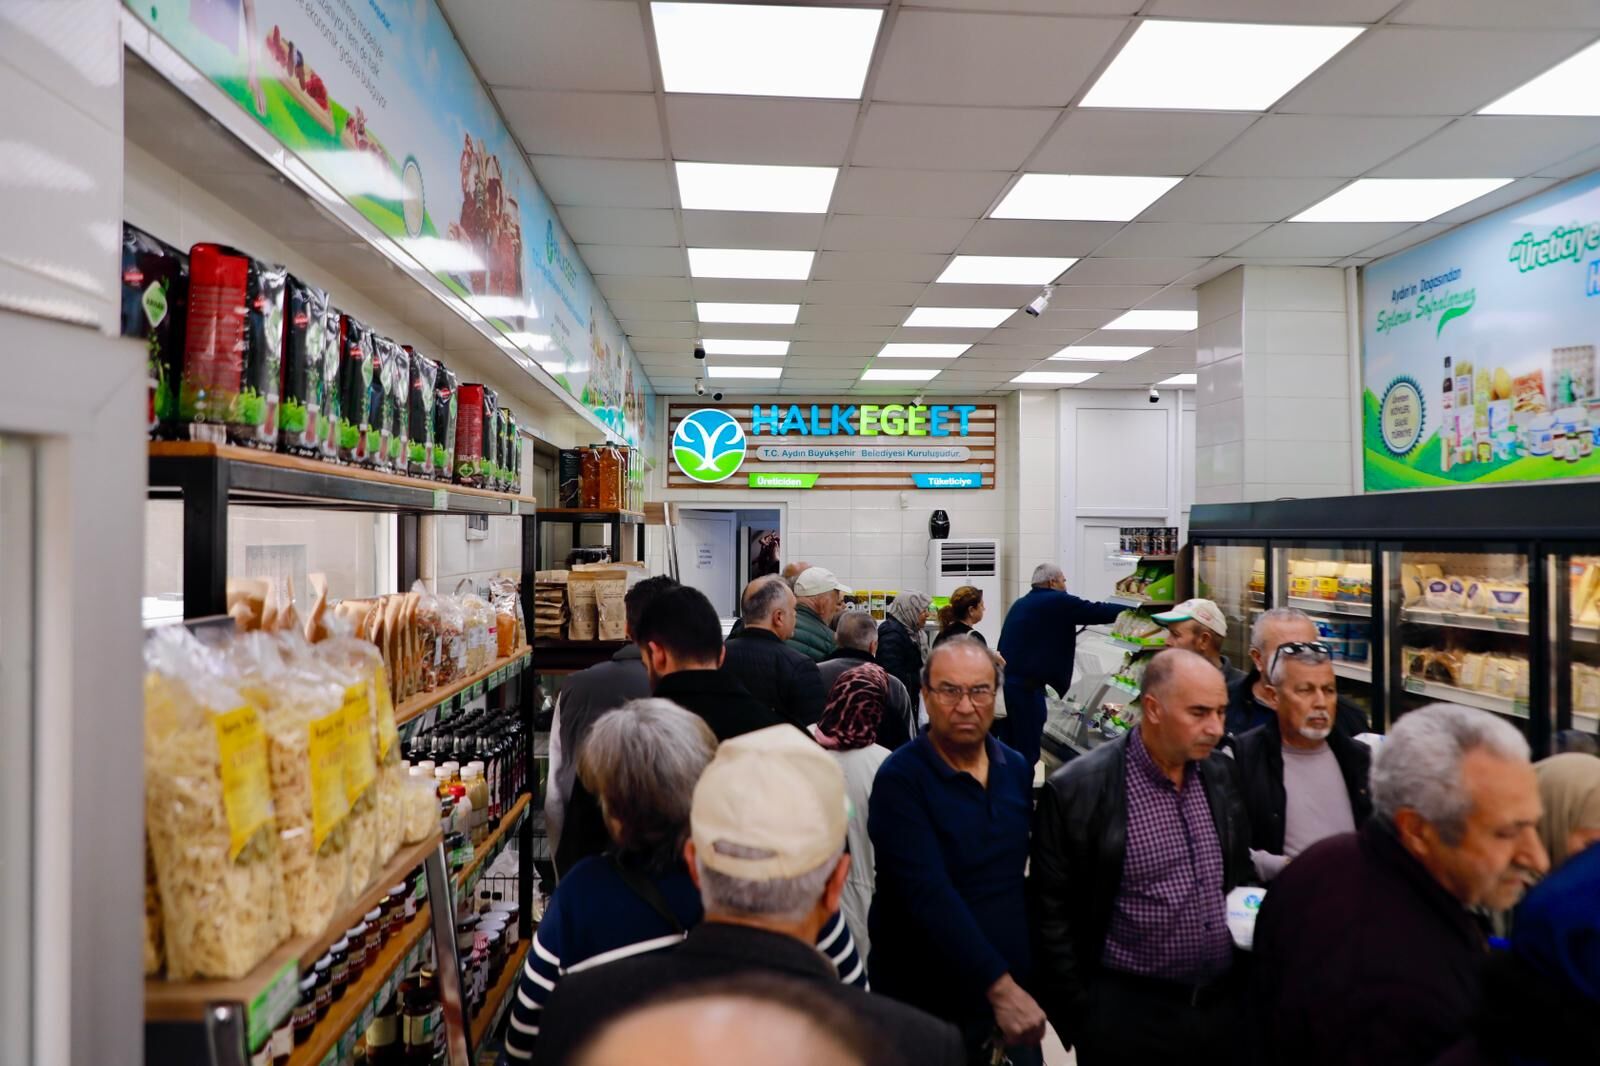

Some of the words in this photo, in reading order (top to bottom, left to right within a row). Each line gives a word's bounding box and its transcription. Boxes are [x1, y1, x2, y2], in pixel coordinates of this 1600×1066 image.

[763, 449, 780, 457] T.C.
[781, 449, 806, 459] Aydın
[808, 449, 856, 459] Büyükşehir
[861, 449, 905, 459] Belediyesi
[757, 476, 802, 486] Üreticiden
[928, 477, 972, 488] Tüketiciye
